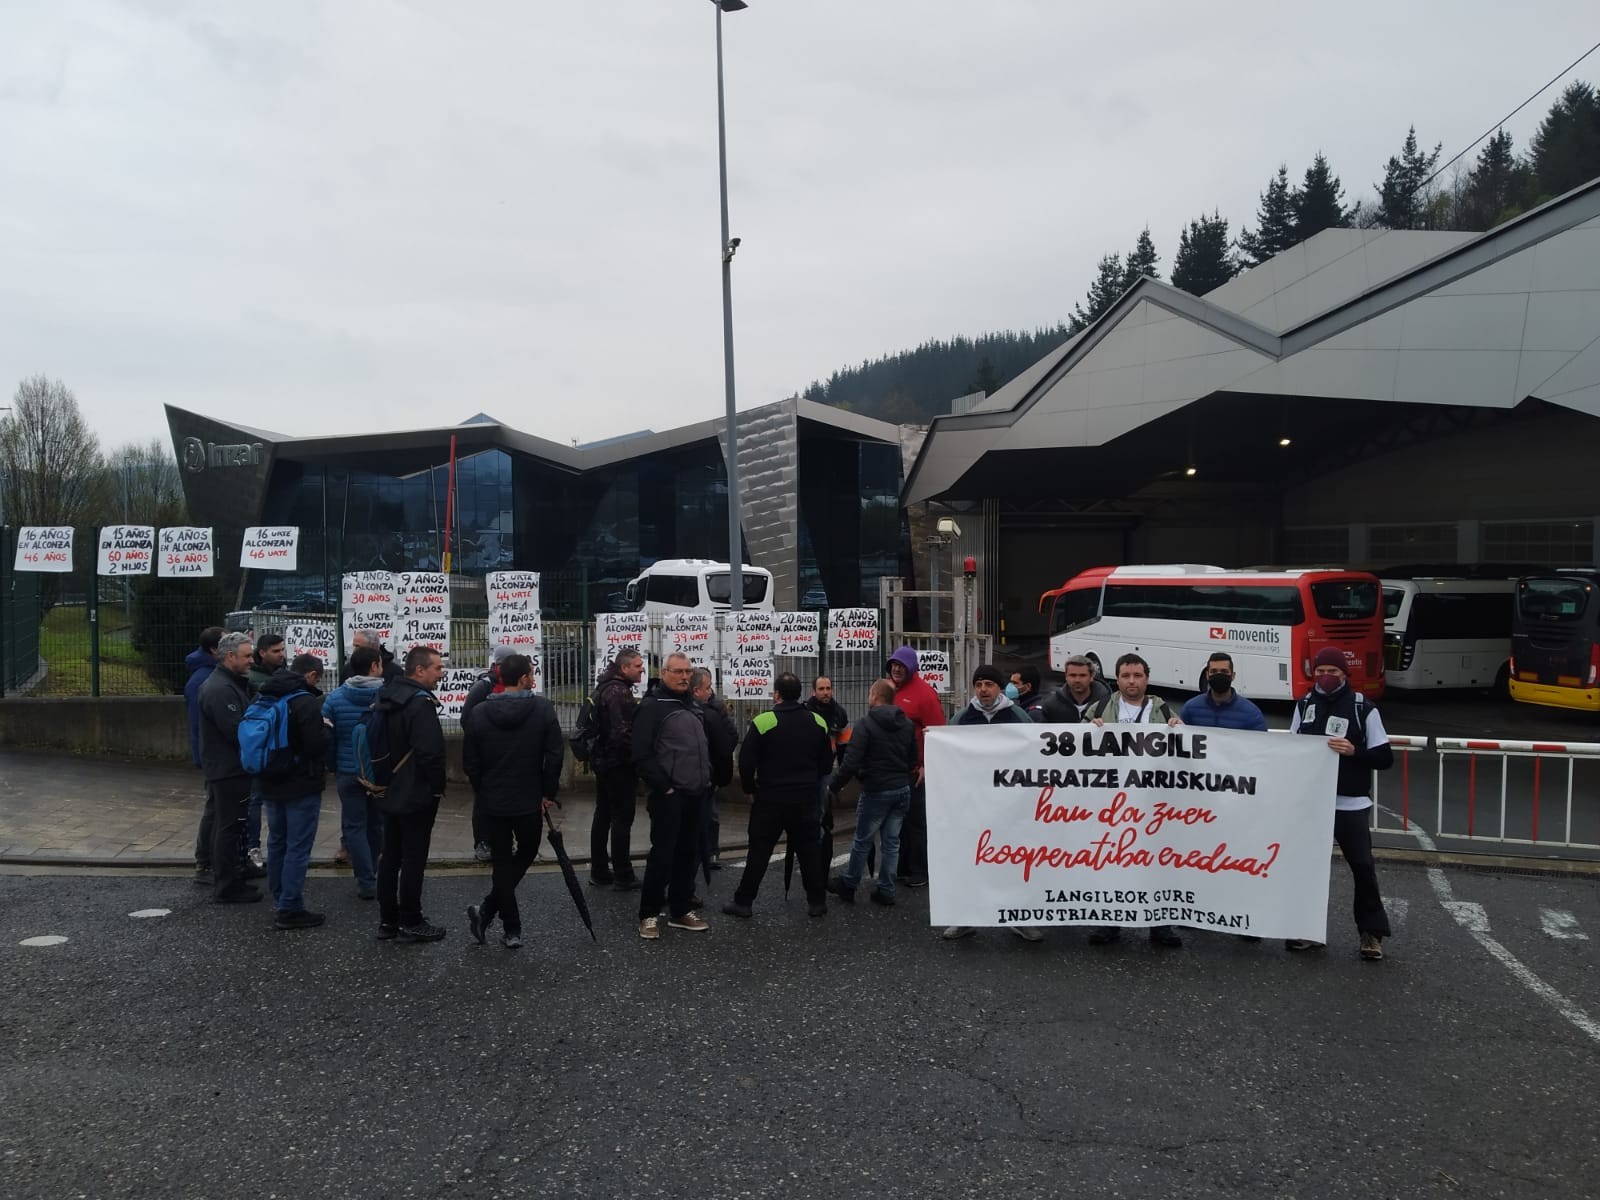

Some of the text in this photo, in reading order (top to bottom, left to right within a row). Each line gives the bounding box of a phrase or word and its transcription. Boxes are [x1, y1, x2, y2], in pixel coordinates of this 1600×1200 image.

[25, 528, 70, 540] 16 AÑOS
[113, 528, 150, 540] 15 AÑOS
[162, 530, 208, 544] 16 AÑOS
[256, 529, 268, 539] 16
[32, 541, 70, 549] ALCONZA
[102, 540, 152, 549] EN ALCONZA
[172, 542, 211, 552] ALCONZA
[24, 551, 67, 562] 46 AÑOS
[108, 550, 149, 562] 60 AÑOS
[167, 553, 208, 564] 36 AÑOS
[250, 550, 264, 559] 46
[109, 562, 148, 574] 2 HIJOS
[170, 564, 202, 574] 1 HIJA
[402, 574, 444, 586] 9 AÑOS
[496, 574, 506, 582] 15
[356, 582, 394, 590] ALCONZA
[410, 586, 448, 594] ALCONZA
[490, 581, 538, 590] ALCONZAN
[352, 593, 390, 604] 30 AÑOS
[422, 594, 444, 604] AÑOS
[497, 591, 509, 601] 44
[522, 600, 528, 610] 1
[404, 606, 410, 616] 2
[834, 609, 874, 622] 16 AÑOS
[353, 612, 363, 622] 16
[499, 612, 534, 624] 11 AÑOS
[604, 614, 644, 624] 15 URTE
[675, 614, 684, 624] 16
[736, 613, 770, 622] 12 AÑOS
[780, 613, 816, 624] 20 AÑOS
[348, 622, 393, 630] ALCONZAN
[406, 620, 444, 632] 19 URTE
[502, 623, 538, 633] ALCONZA
[606, 624, 648, 632] ALCONZAN
[666, 624, 708, 632] ALCONZAN
[737, 624, 772, 632] ALCONZA
[784, 624, 818, 632] ALCONZA
[842, 620, 877, 628] ALCONZA
[306, 627, 335, 641] AÑOS
[402, 632, 446, 642] ALCONZAN
[607, 634, 619, 644] 44
[674, 634, 687, 642] 39
[736, 634, 748, 644] 36
[782, 635, 791, 643] 41
[838, 629, 874, 639] 43 AÑOS
[1228, 627, 1280, 644] moventis
[299, 638, 335, 648] ALCONZA
[498, 634, 534, 645] 47 AÑOS
[836, 640, 874, 648] 2 HIJOS
[608, 644, 615, 654] 2
[684, 644, 704, 652] SEME
[738, 644, 743, 655] 1
[782, 644, 788, 654] 2
[920, 652, 944, 662] AÑOS
[730, 658, 770, 668] 16 AÑOS
[736, 670, 772, 678] ALCONZA
[924, 672, 944, 682] AÑOS
[733, 678, 768, 688] 49 AÑOS
[736, 687, 763, 697] 1 HIJO
[440, 694, 454, 702] 40
[438, 705, 446, 716] 2
[1040, 732, 1207, 760] 38 LANGILE
[994, 768, 1256, 796] KALERATZE ARRISKUAN
[1034, 786, 1093, 824] hau
[1098, 792, 1145, 827] da
[975, 828, 1280, 882] kooperatiba eredua?
[1045, 890, 1196, 904] LANGILEOK GURE
[998, 908, 1250, 930] INDUSTRIAREN DEFENTSAN!
